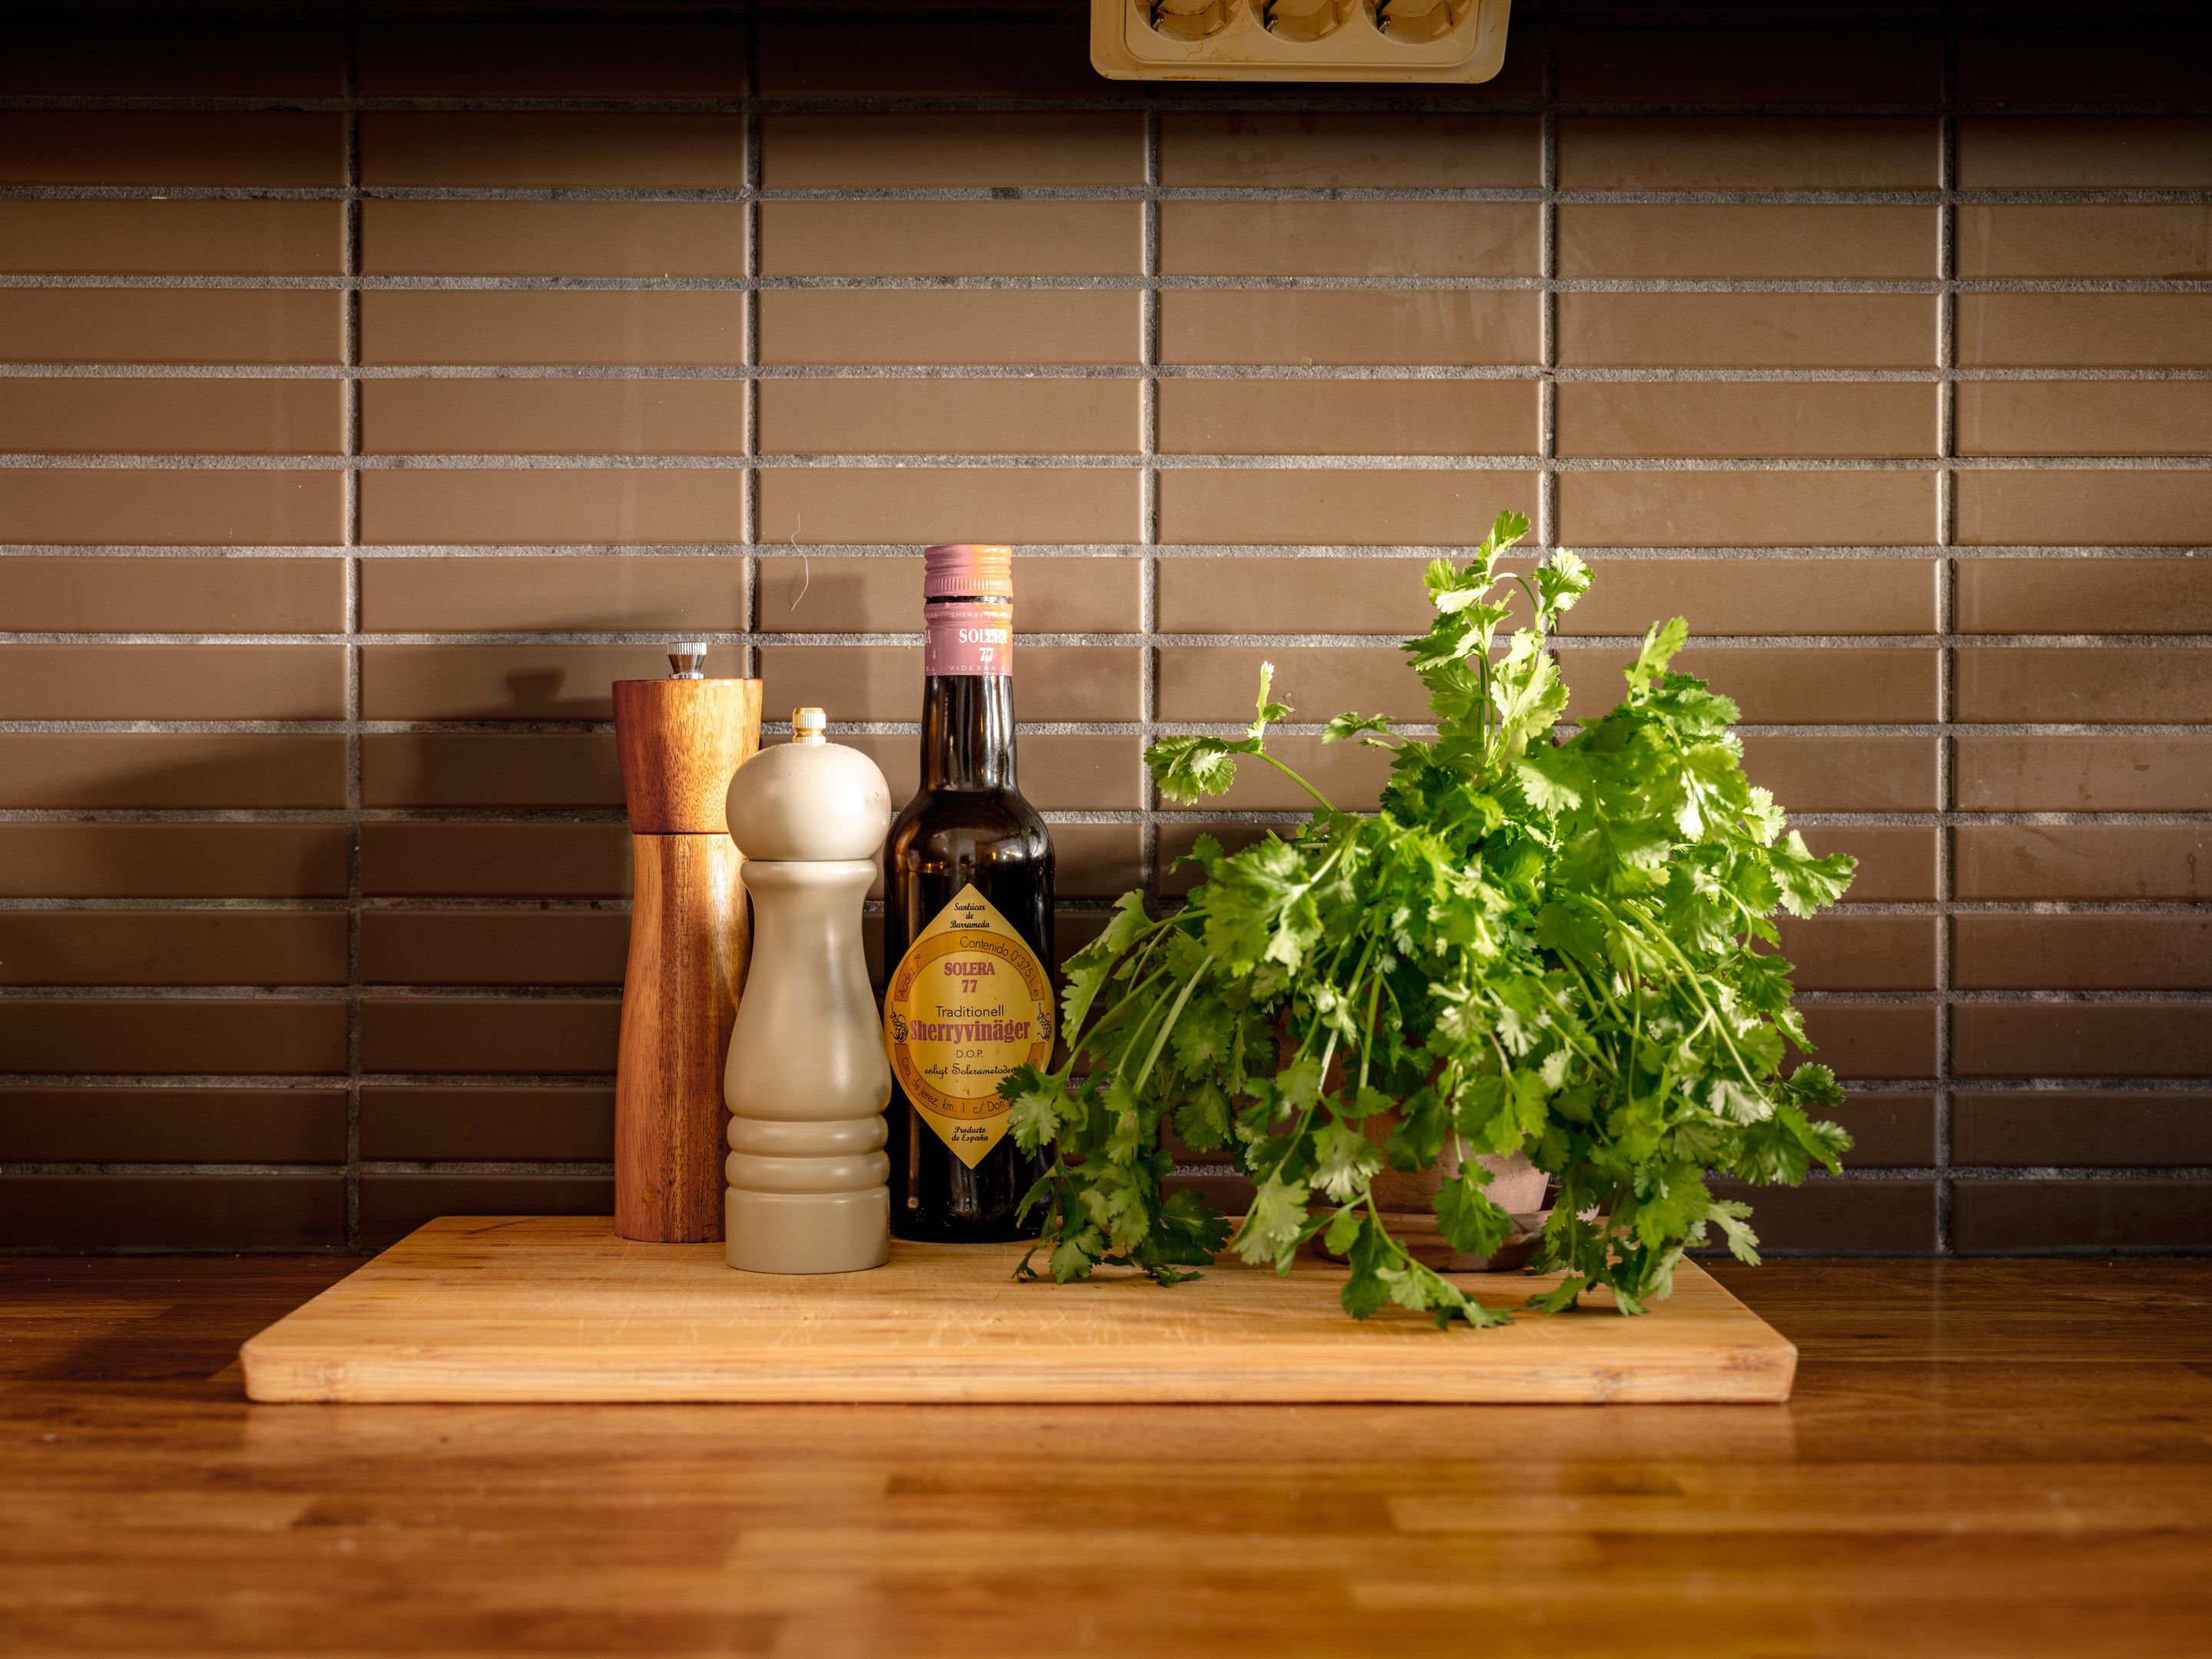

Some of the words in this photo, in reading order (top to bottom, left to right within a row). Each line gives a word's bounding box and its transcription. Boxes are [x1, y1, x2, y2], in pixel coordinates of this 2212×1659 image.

[959, 628, 1008, 644] SOLERA
[979, 647, 995, 662] 77
[954, 902, 985, 911] Sanlúcar
[965, 911, 974, 919] de
[949, 920, 990, 929] Barrameda
[959, 935, 1009, 956] Contenido
[944, 962, 995, 976] SOLERA
[899, 968, 916, 998] Acidez
[962, 979, 978, 993] 77
[935, 1005, 1004, 1018] Traditionell
[910, 1019, 1031, 1045] Sherryvinäger
[955, 1049, 984, 1058] D.O.P.
[924, 1064, 949, 1079] enligt
[902, 1057, 912, 1079] Ctra.
[912, 1078, 920, 1091] de
[942, 1098, 956, 1112] km.
[987, 1101, 1005, 1112] Don
[962, 1134, 988, 1144] España
